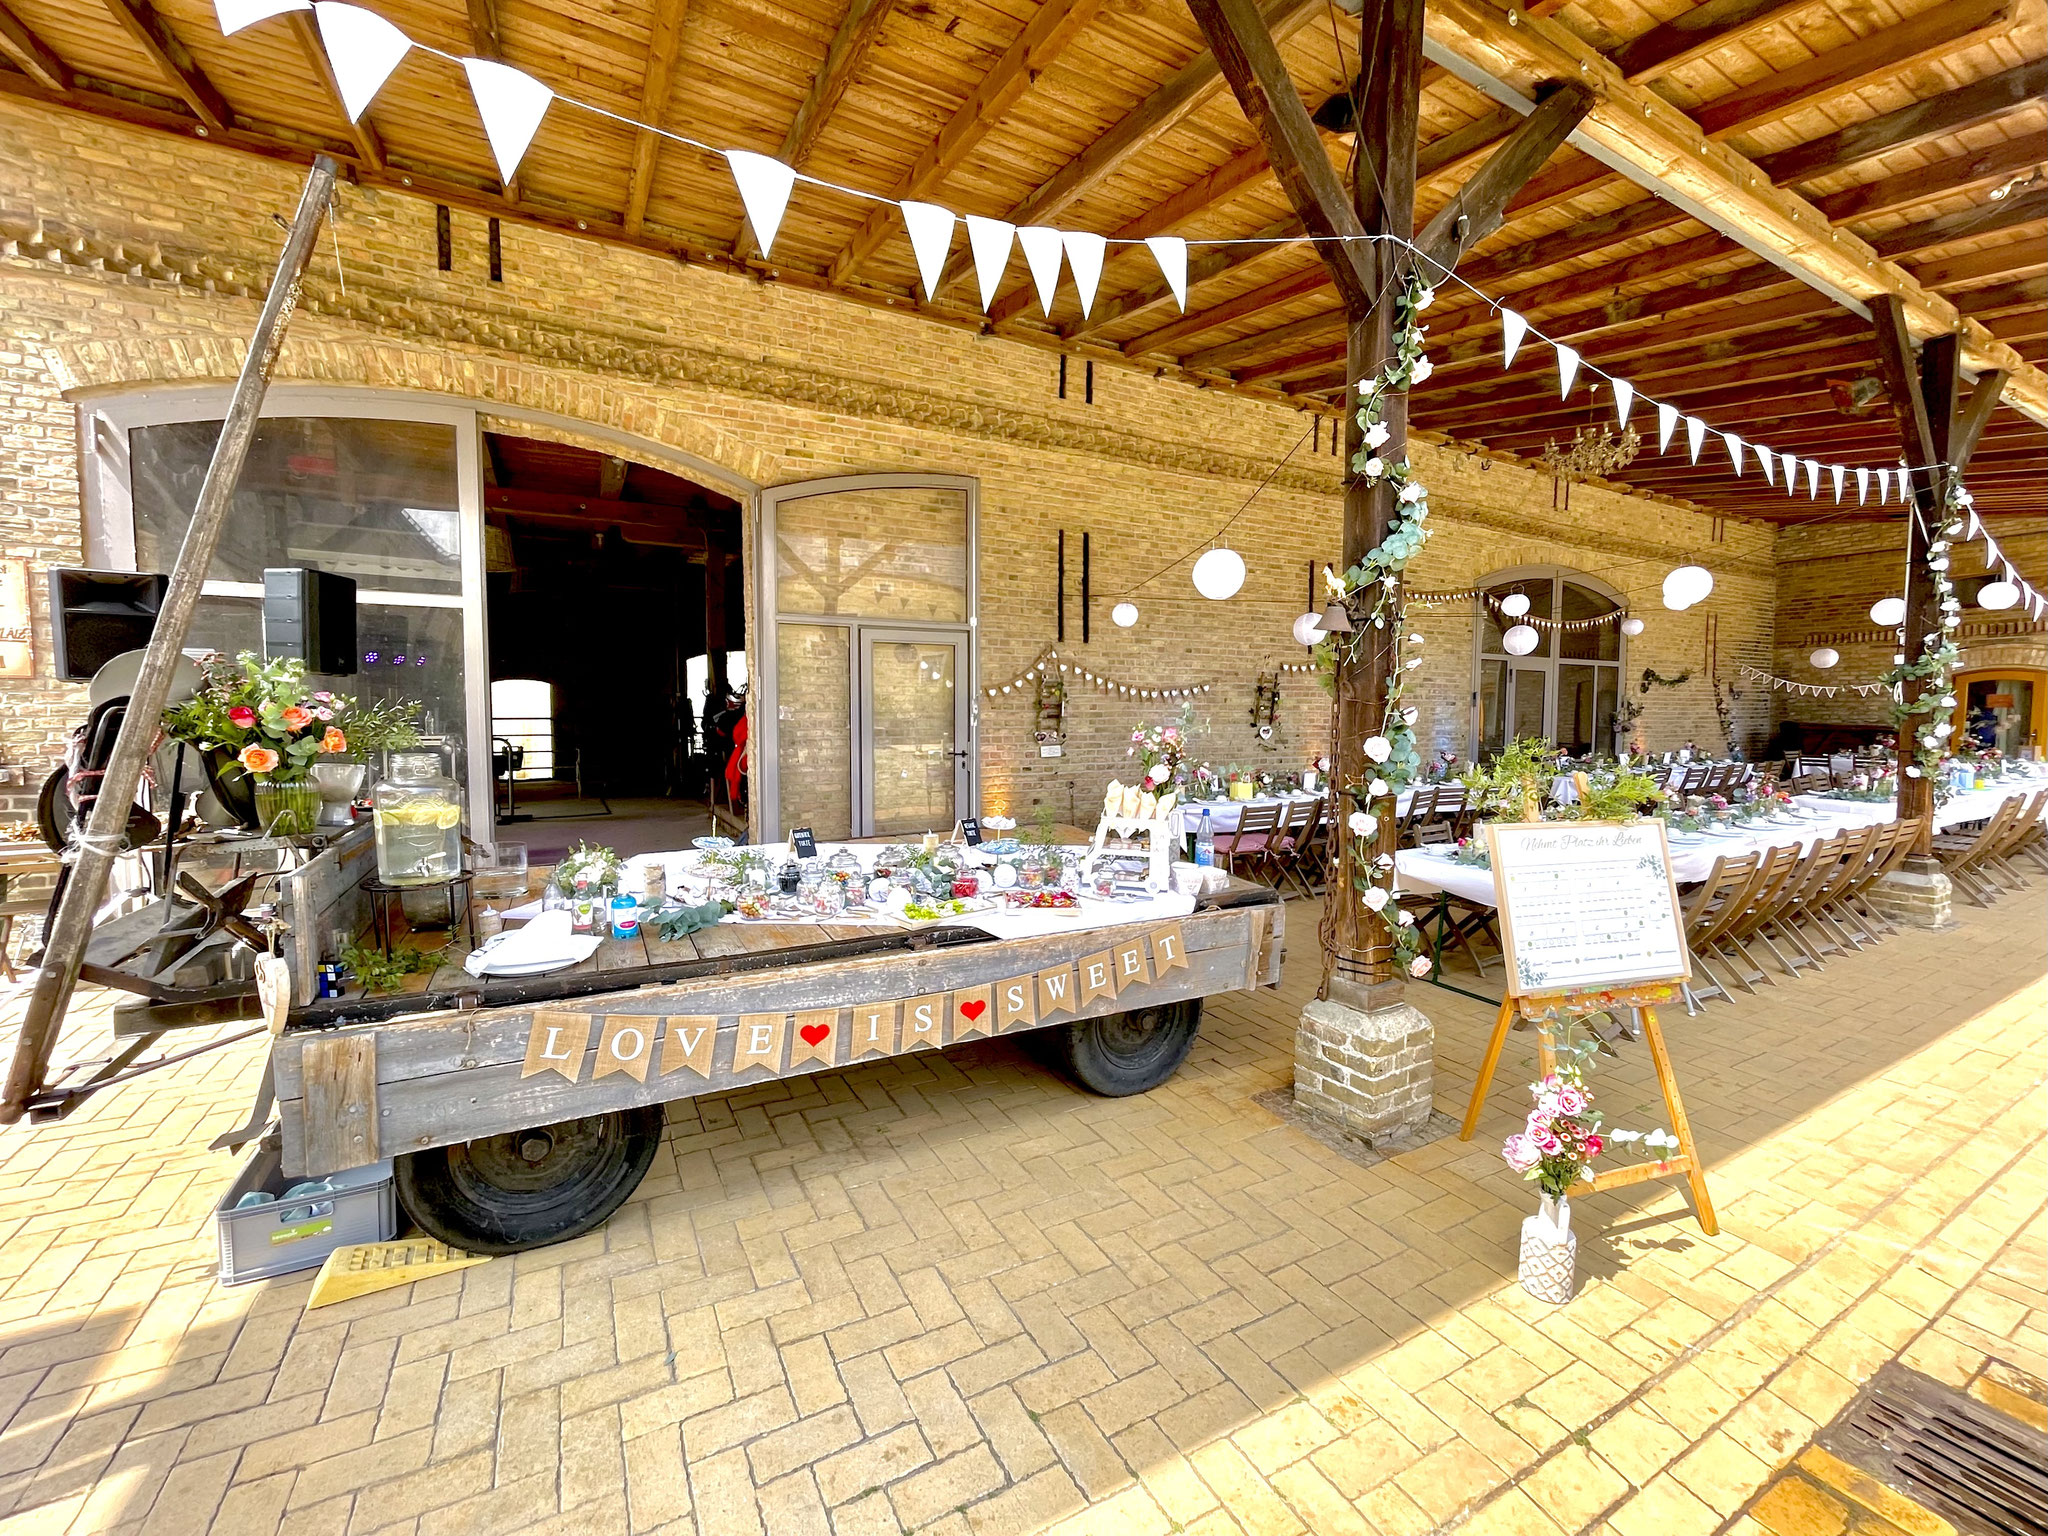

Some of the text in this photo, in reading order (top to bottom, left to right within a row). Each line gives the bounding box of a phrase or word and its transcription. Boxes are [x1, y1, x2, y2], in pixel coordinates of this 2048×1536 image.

[1520, 837, 1558, 850] Nehmt
[1560, 834, 1595, 850] Platz
[1612, 831, 1643, 847] Lieben
[540, 934, 1178, 1061] LOVE IS SWEET
